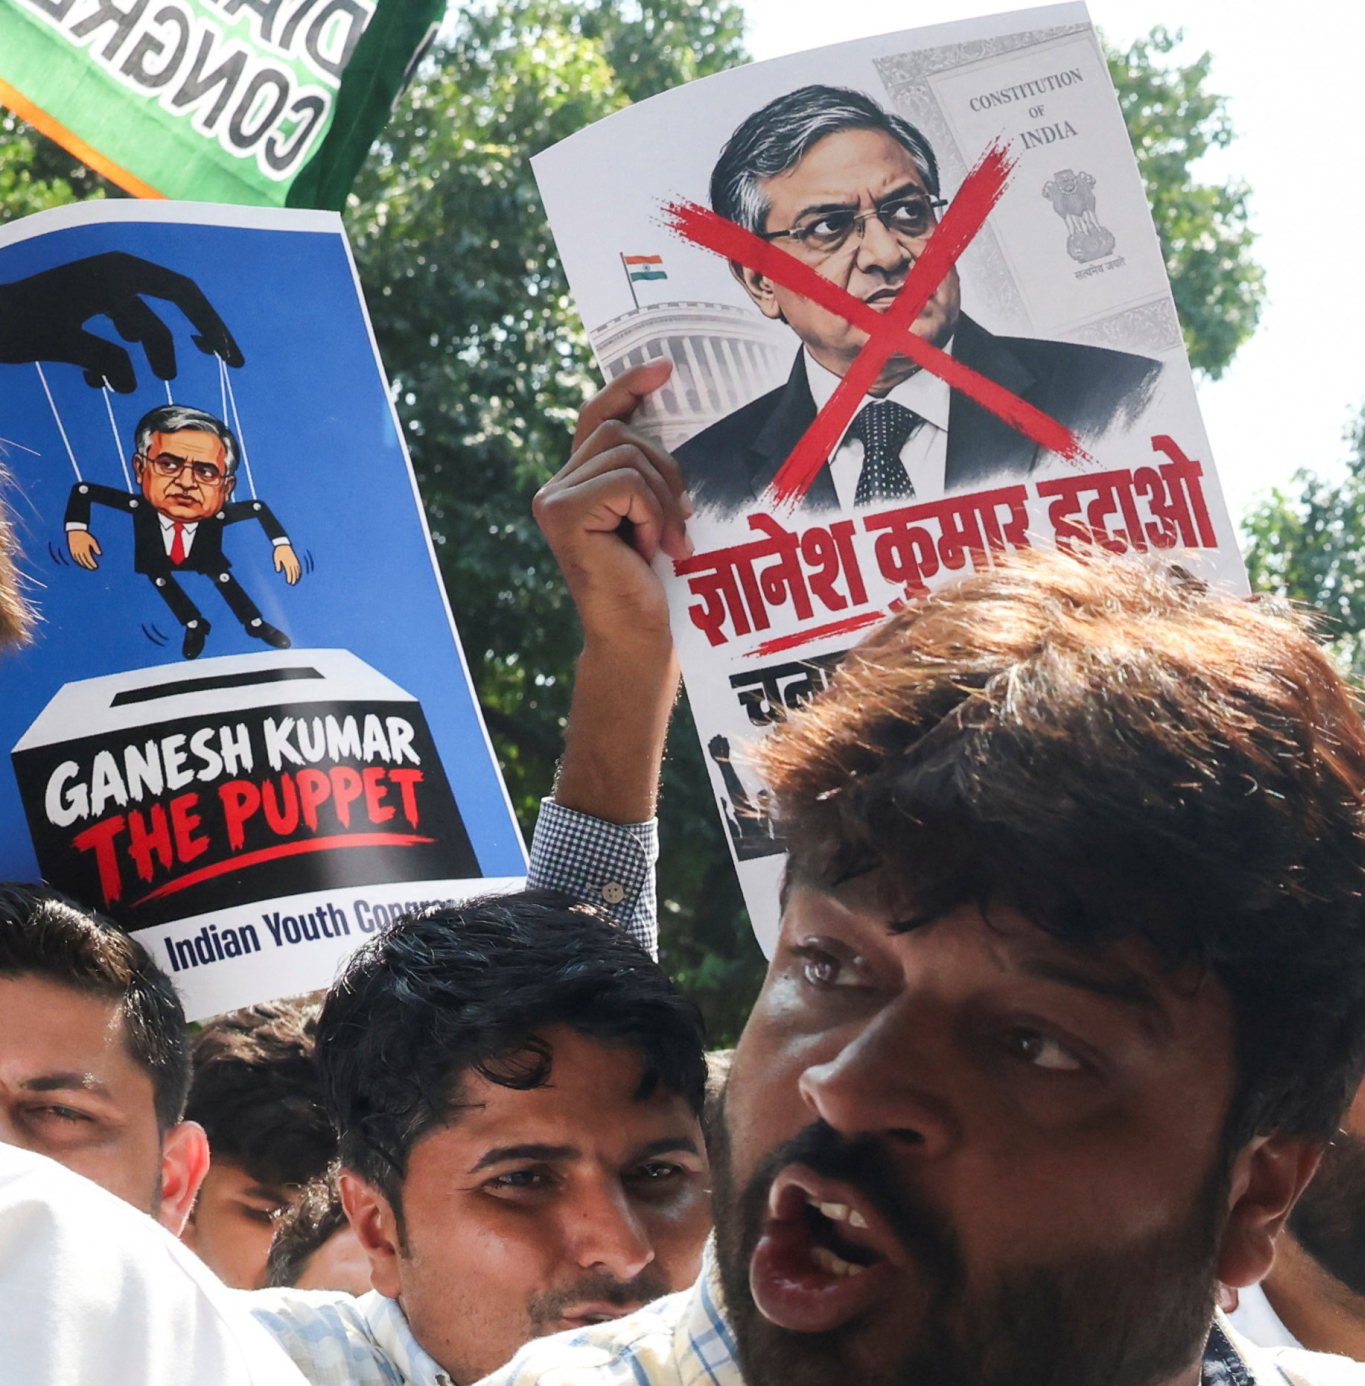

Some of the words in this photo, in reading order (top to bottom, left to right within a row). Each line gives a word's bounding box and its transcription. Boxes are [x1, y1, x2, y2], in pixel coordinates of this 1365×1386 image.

[969, 68, 1084, 112] CONSTITUTION
[1028, 105, 1047, 119] OF
[1019, 120, 1078, 150] INDIA
[673, 512, 869, 647] ज्ञानेश
[45, 723, 253, 828] GANESH
[264, 714, 420, 771] KUMAR
[71, 793, 210, 906] THE
[217, 766, 424, 852] PUPPET
[164, 925, 261, 973] Indian
[262, 904, 348, 947] Youth
